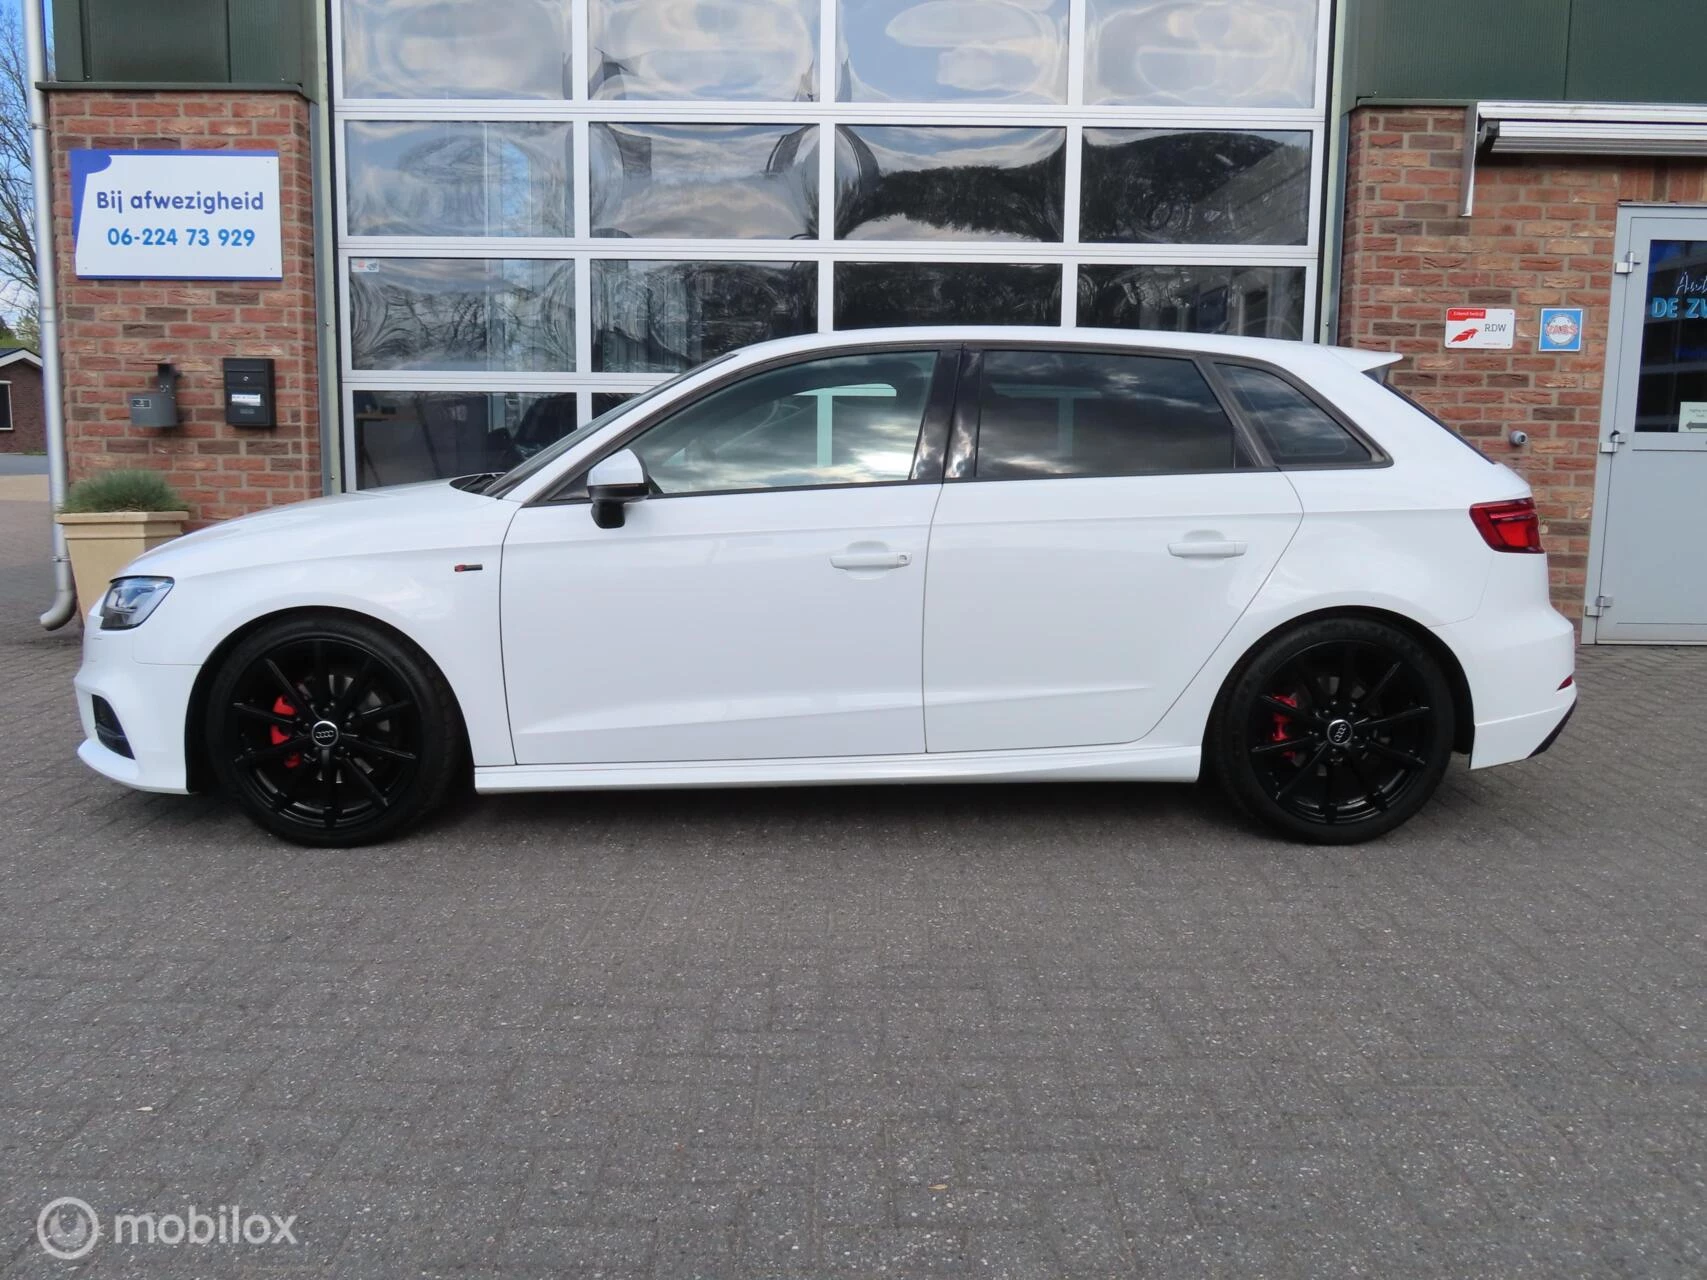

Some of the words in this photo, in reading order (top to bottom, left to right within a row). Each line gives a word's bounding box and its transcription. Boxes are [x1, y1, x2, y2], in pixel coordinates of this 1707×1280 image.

[96, 191, 123, 214] Bij
[130, 190, 264, 215] afwezigheid
[107, 227, 179, 247] 06-224
[186, 228, 211, 248] 73
[217, 228, 256, 248] 929
[1651, 297, 1679, 318] DE
[1484, 323, 1507, 332] RDW
